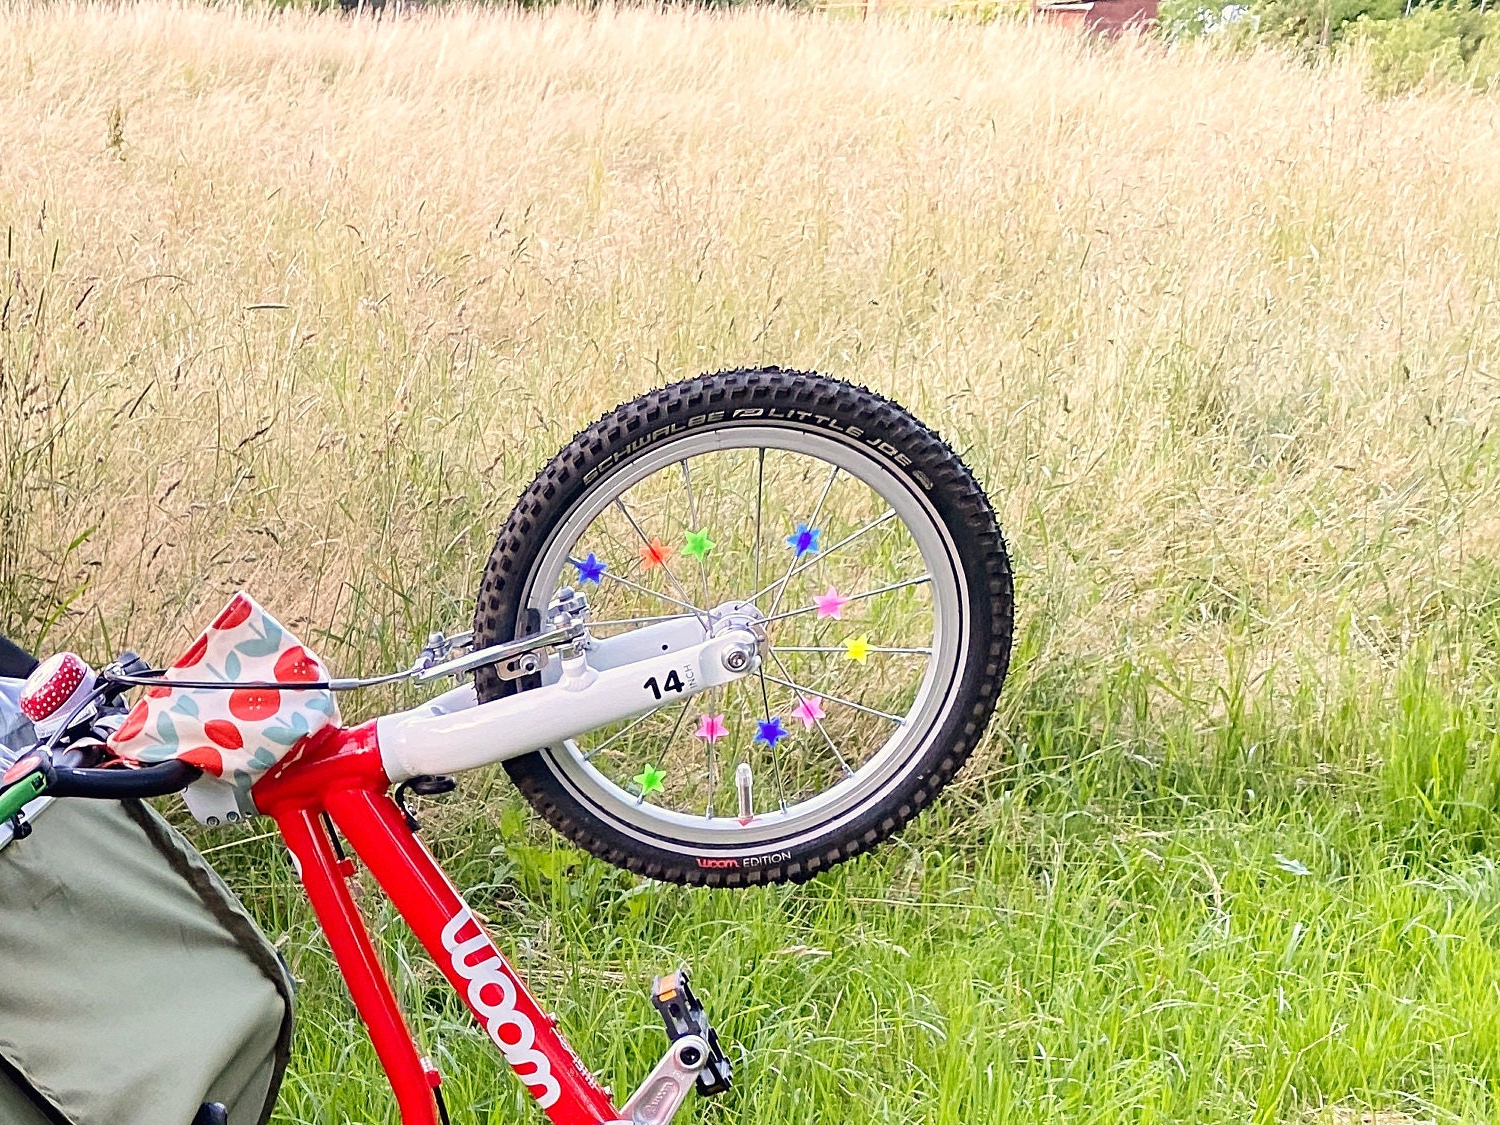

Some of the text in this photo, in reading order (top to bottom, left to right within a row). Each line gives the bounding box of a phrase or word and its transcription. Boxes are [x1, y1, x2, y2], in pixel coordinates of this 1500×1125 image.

[582, 407, 913, 486] SCHWALBE LITTLE JOE
[643, 669, 685, 700] 14
[683, 664, 698, 689] INCH
[696, 851, 792, 869] woom EDITION
[440, 906, 561, 1110] woom
